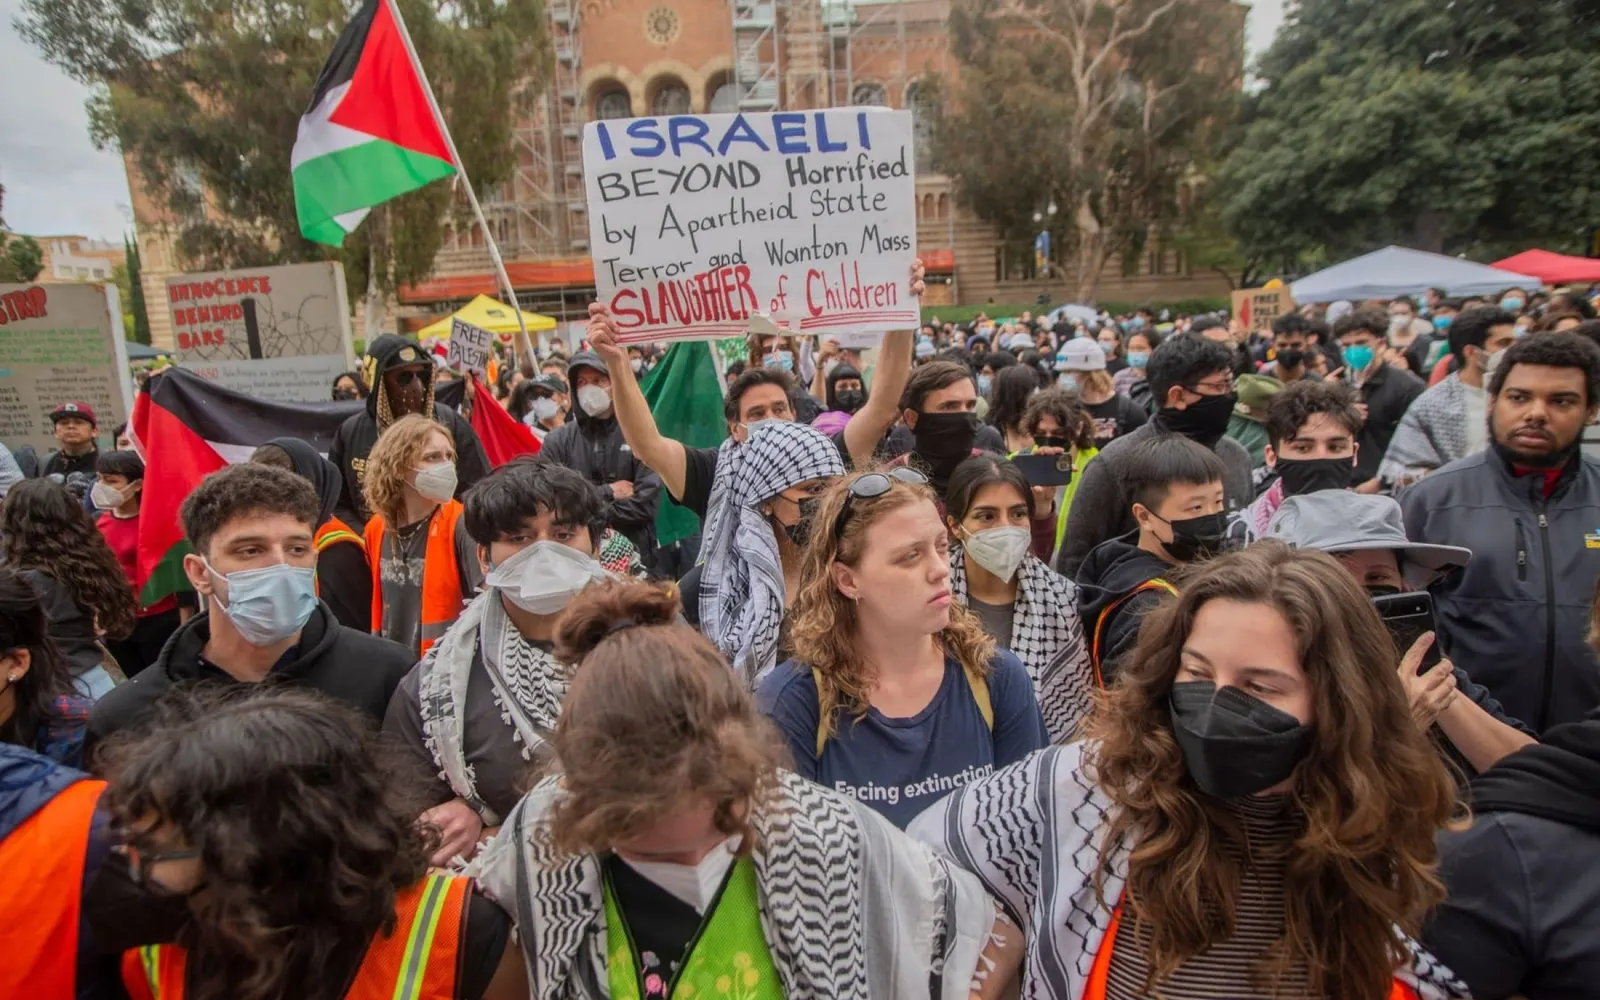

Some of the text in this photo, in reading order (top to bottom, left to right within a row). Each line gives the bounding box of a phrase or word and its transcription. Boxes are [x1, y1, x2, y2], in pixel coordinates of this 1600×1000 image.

[596, 111, 871, 160] ISRAELI
[597, 145, 909, 202] BEYOND Horrified
[602, 182, 888, 256] by Apartheid State
[602, 223, 911, 287] Terror and Wanton Mass
[169, 275, 272, 302] INNOCENCE
[770, 274, 788, 312] of
[806, 260, 897, 316] Children
[174, 303, 243, 326] BEHIND
[452, 320, 489, 348] FREE
[177, 328, 224, 350] BARS
[834, 762, 993, 805] Facing extinction
